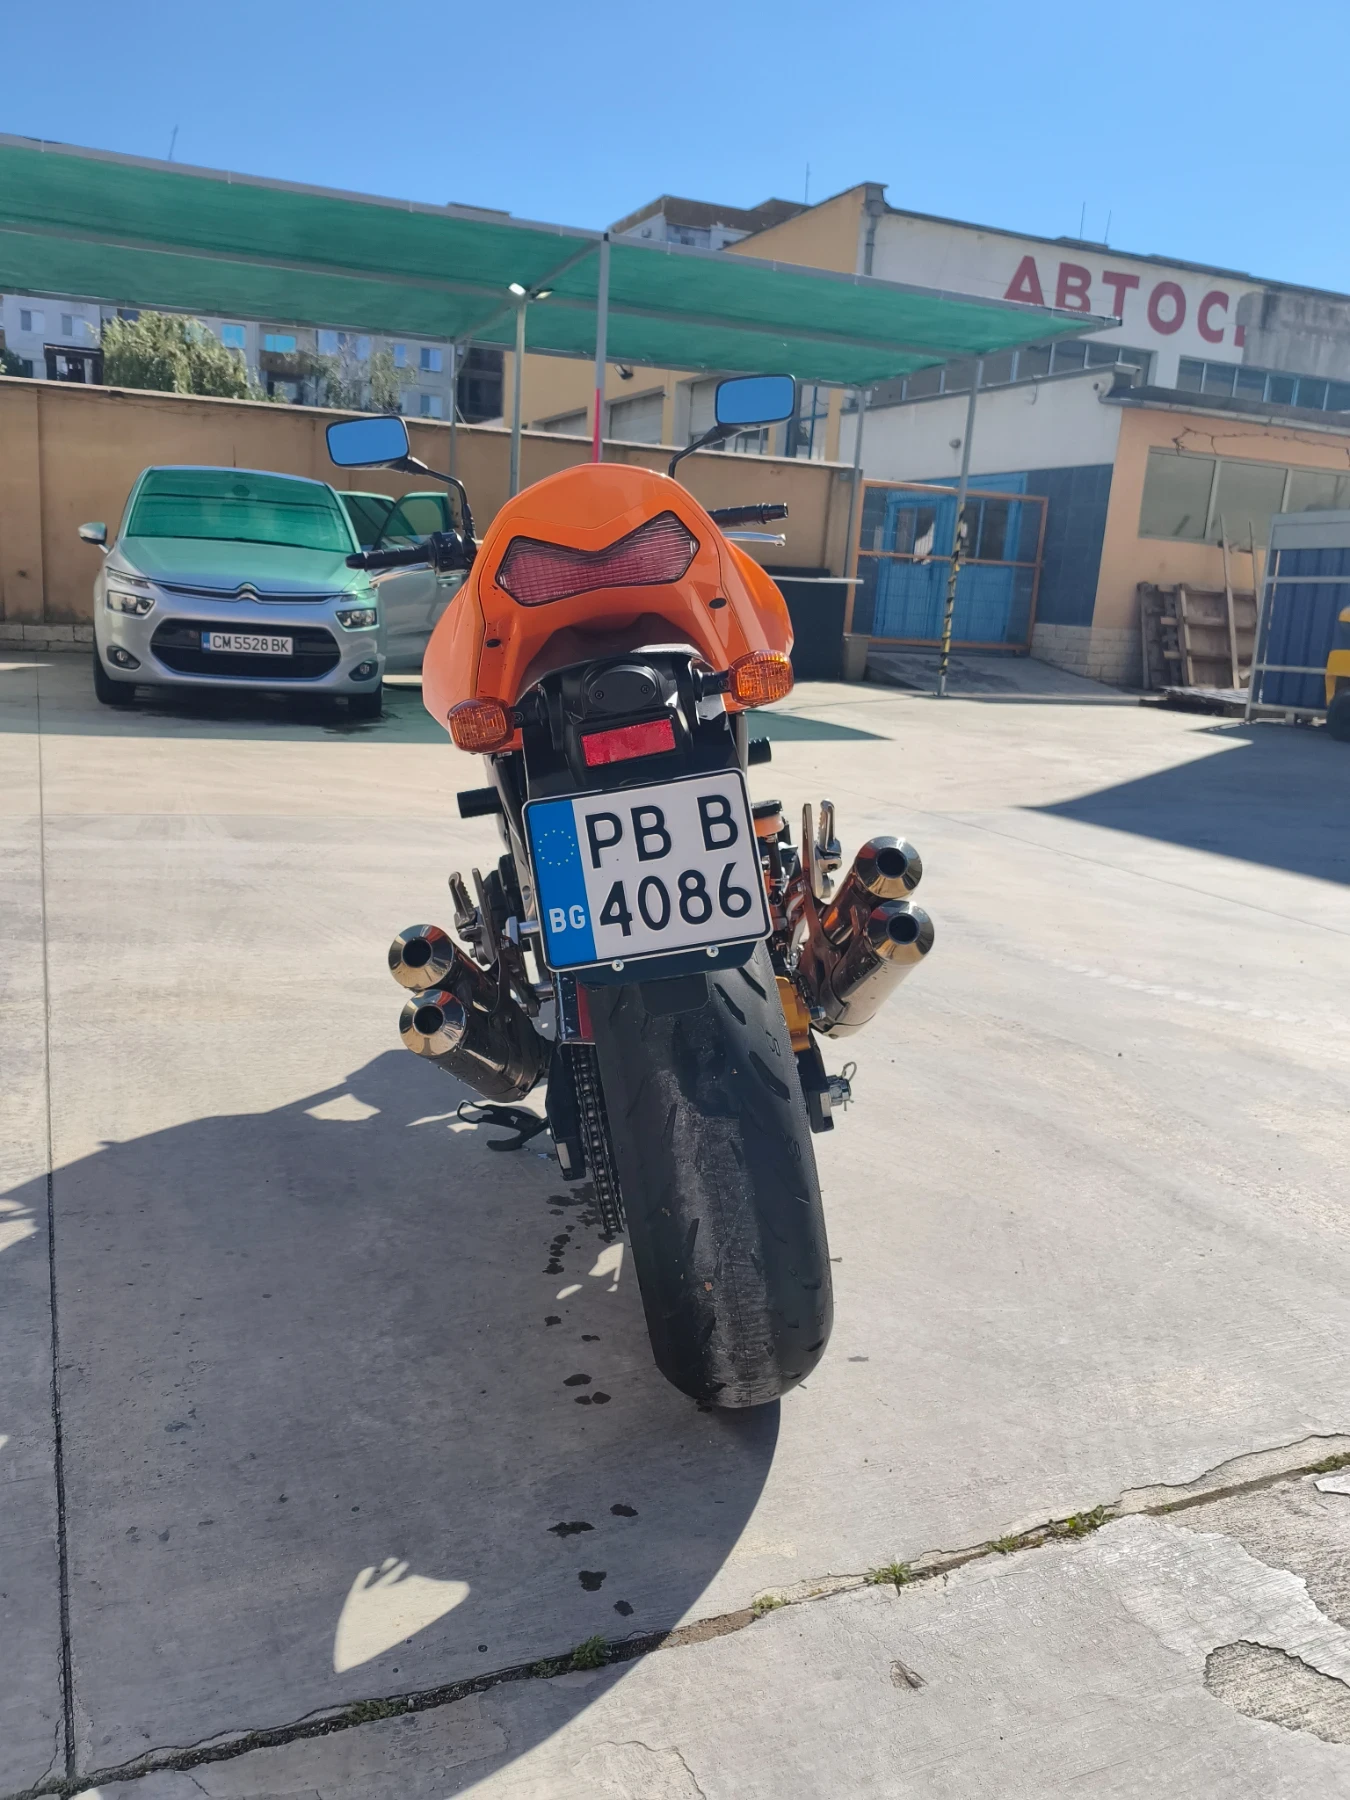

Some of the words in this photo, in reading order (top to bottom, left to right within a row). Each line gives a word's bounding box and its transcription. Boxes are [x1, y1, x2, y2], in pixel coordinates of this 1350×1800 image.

[212, 634, 232, 649] CM
[234, 636, 269, 652] 5528
[271, 638, 289, 653] BK
[584, 804, 673, 869] PB
[696, 793, 740, 852] B
[548, 903, 586, 934] BG
[599, 861, 752, 938] 4086
